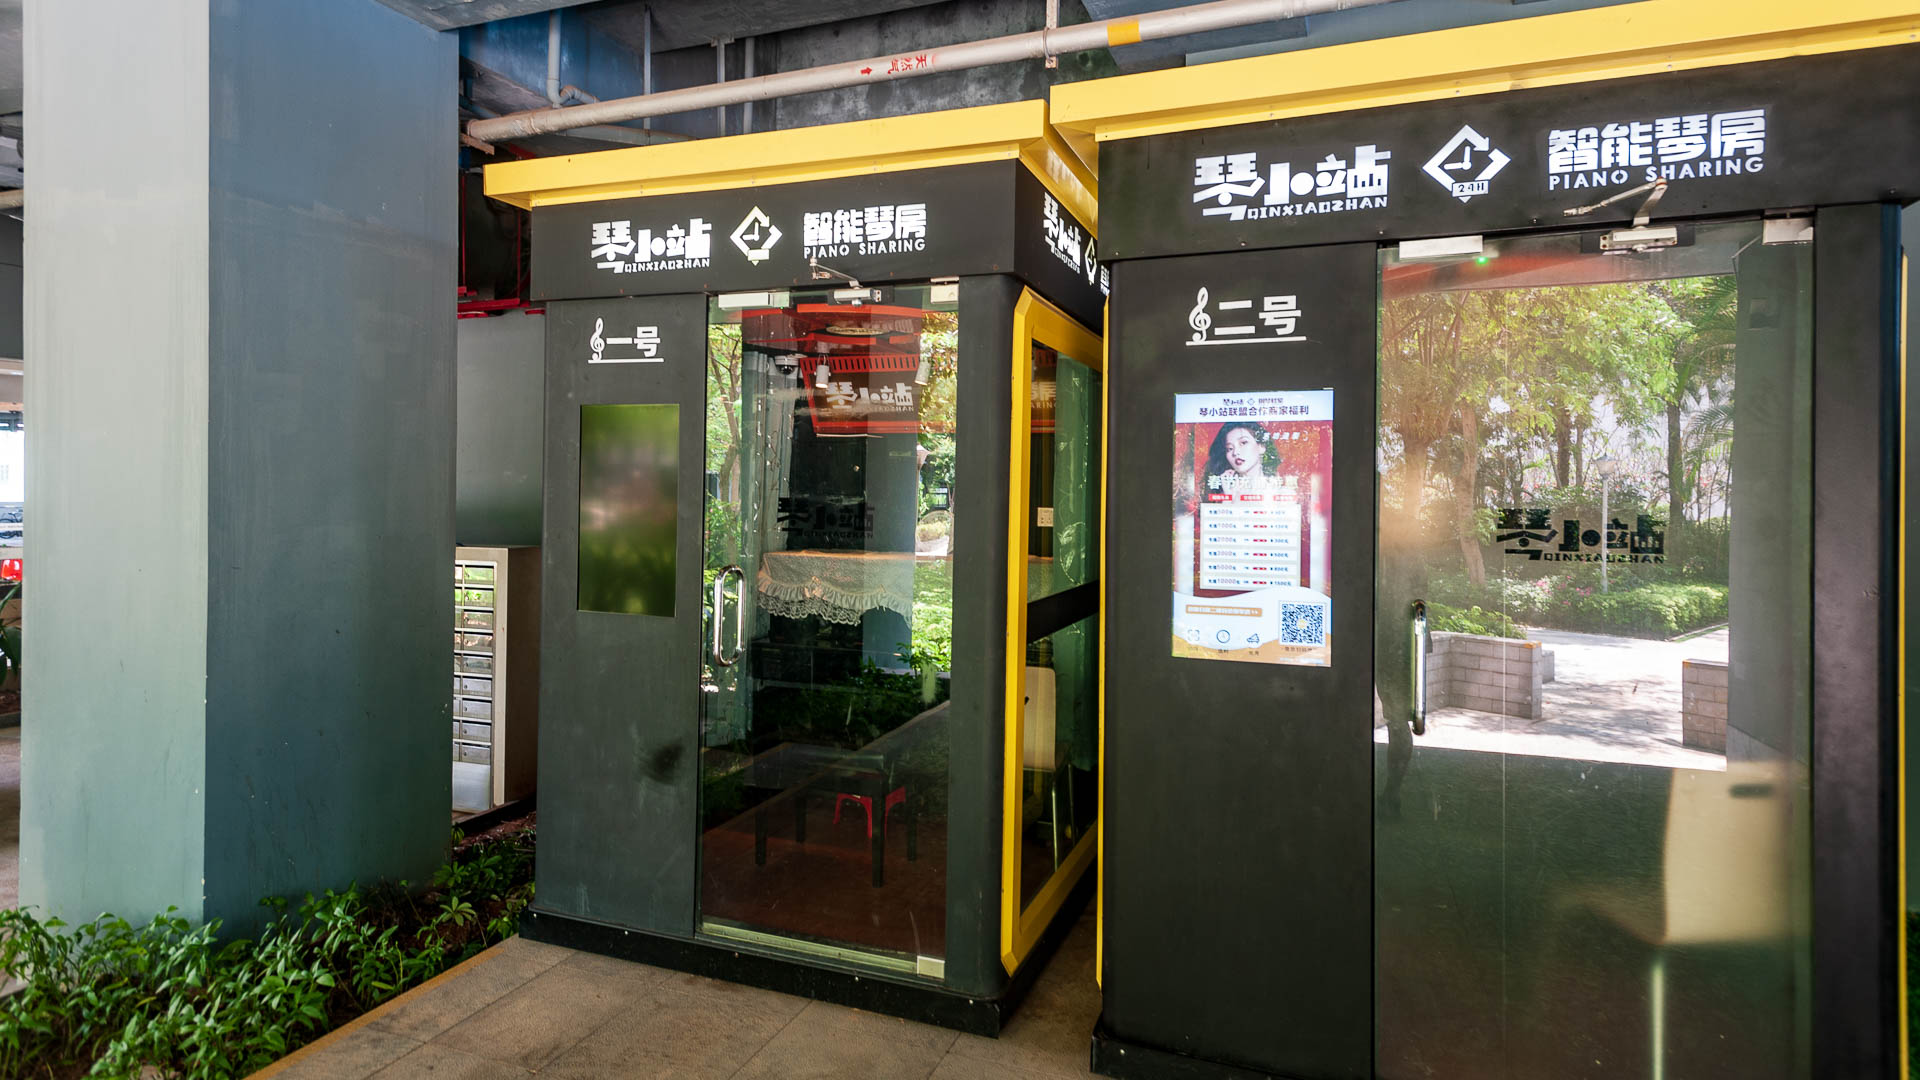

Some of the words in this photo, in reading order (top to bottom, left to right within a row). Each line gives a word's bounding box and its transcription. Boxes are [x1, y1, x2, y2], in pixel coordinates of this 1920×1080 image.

[1548, 108, 1766, 174] 智能琴房
[1192, 144, 1392, 222] 琴小站
[1458, 182, 1485, 193] 24H
[1549, 169, 1629, 190] PIANO
[1645, 156, 1764, 182] SHARING
[803, 203, 927, 246] 智能琴房
[1247, 196, 1389, 220] QINXIAOZHAN
[591, 218, 712, 273] 琴小站
[803, 244, 850, 259] PIANO
[858, 238, 926, 255] SHARING
[624, 258, 710, 273] QINXIAOZHAN
[1214, 294, 1302, 335] 二号
[606, 326, 661, 358] 一号
[1496, 508, 1668, 561] 琴小站
